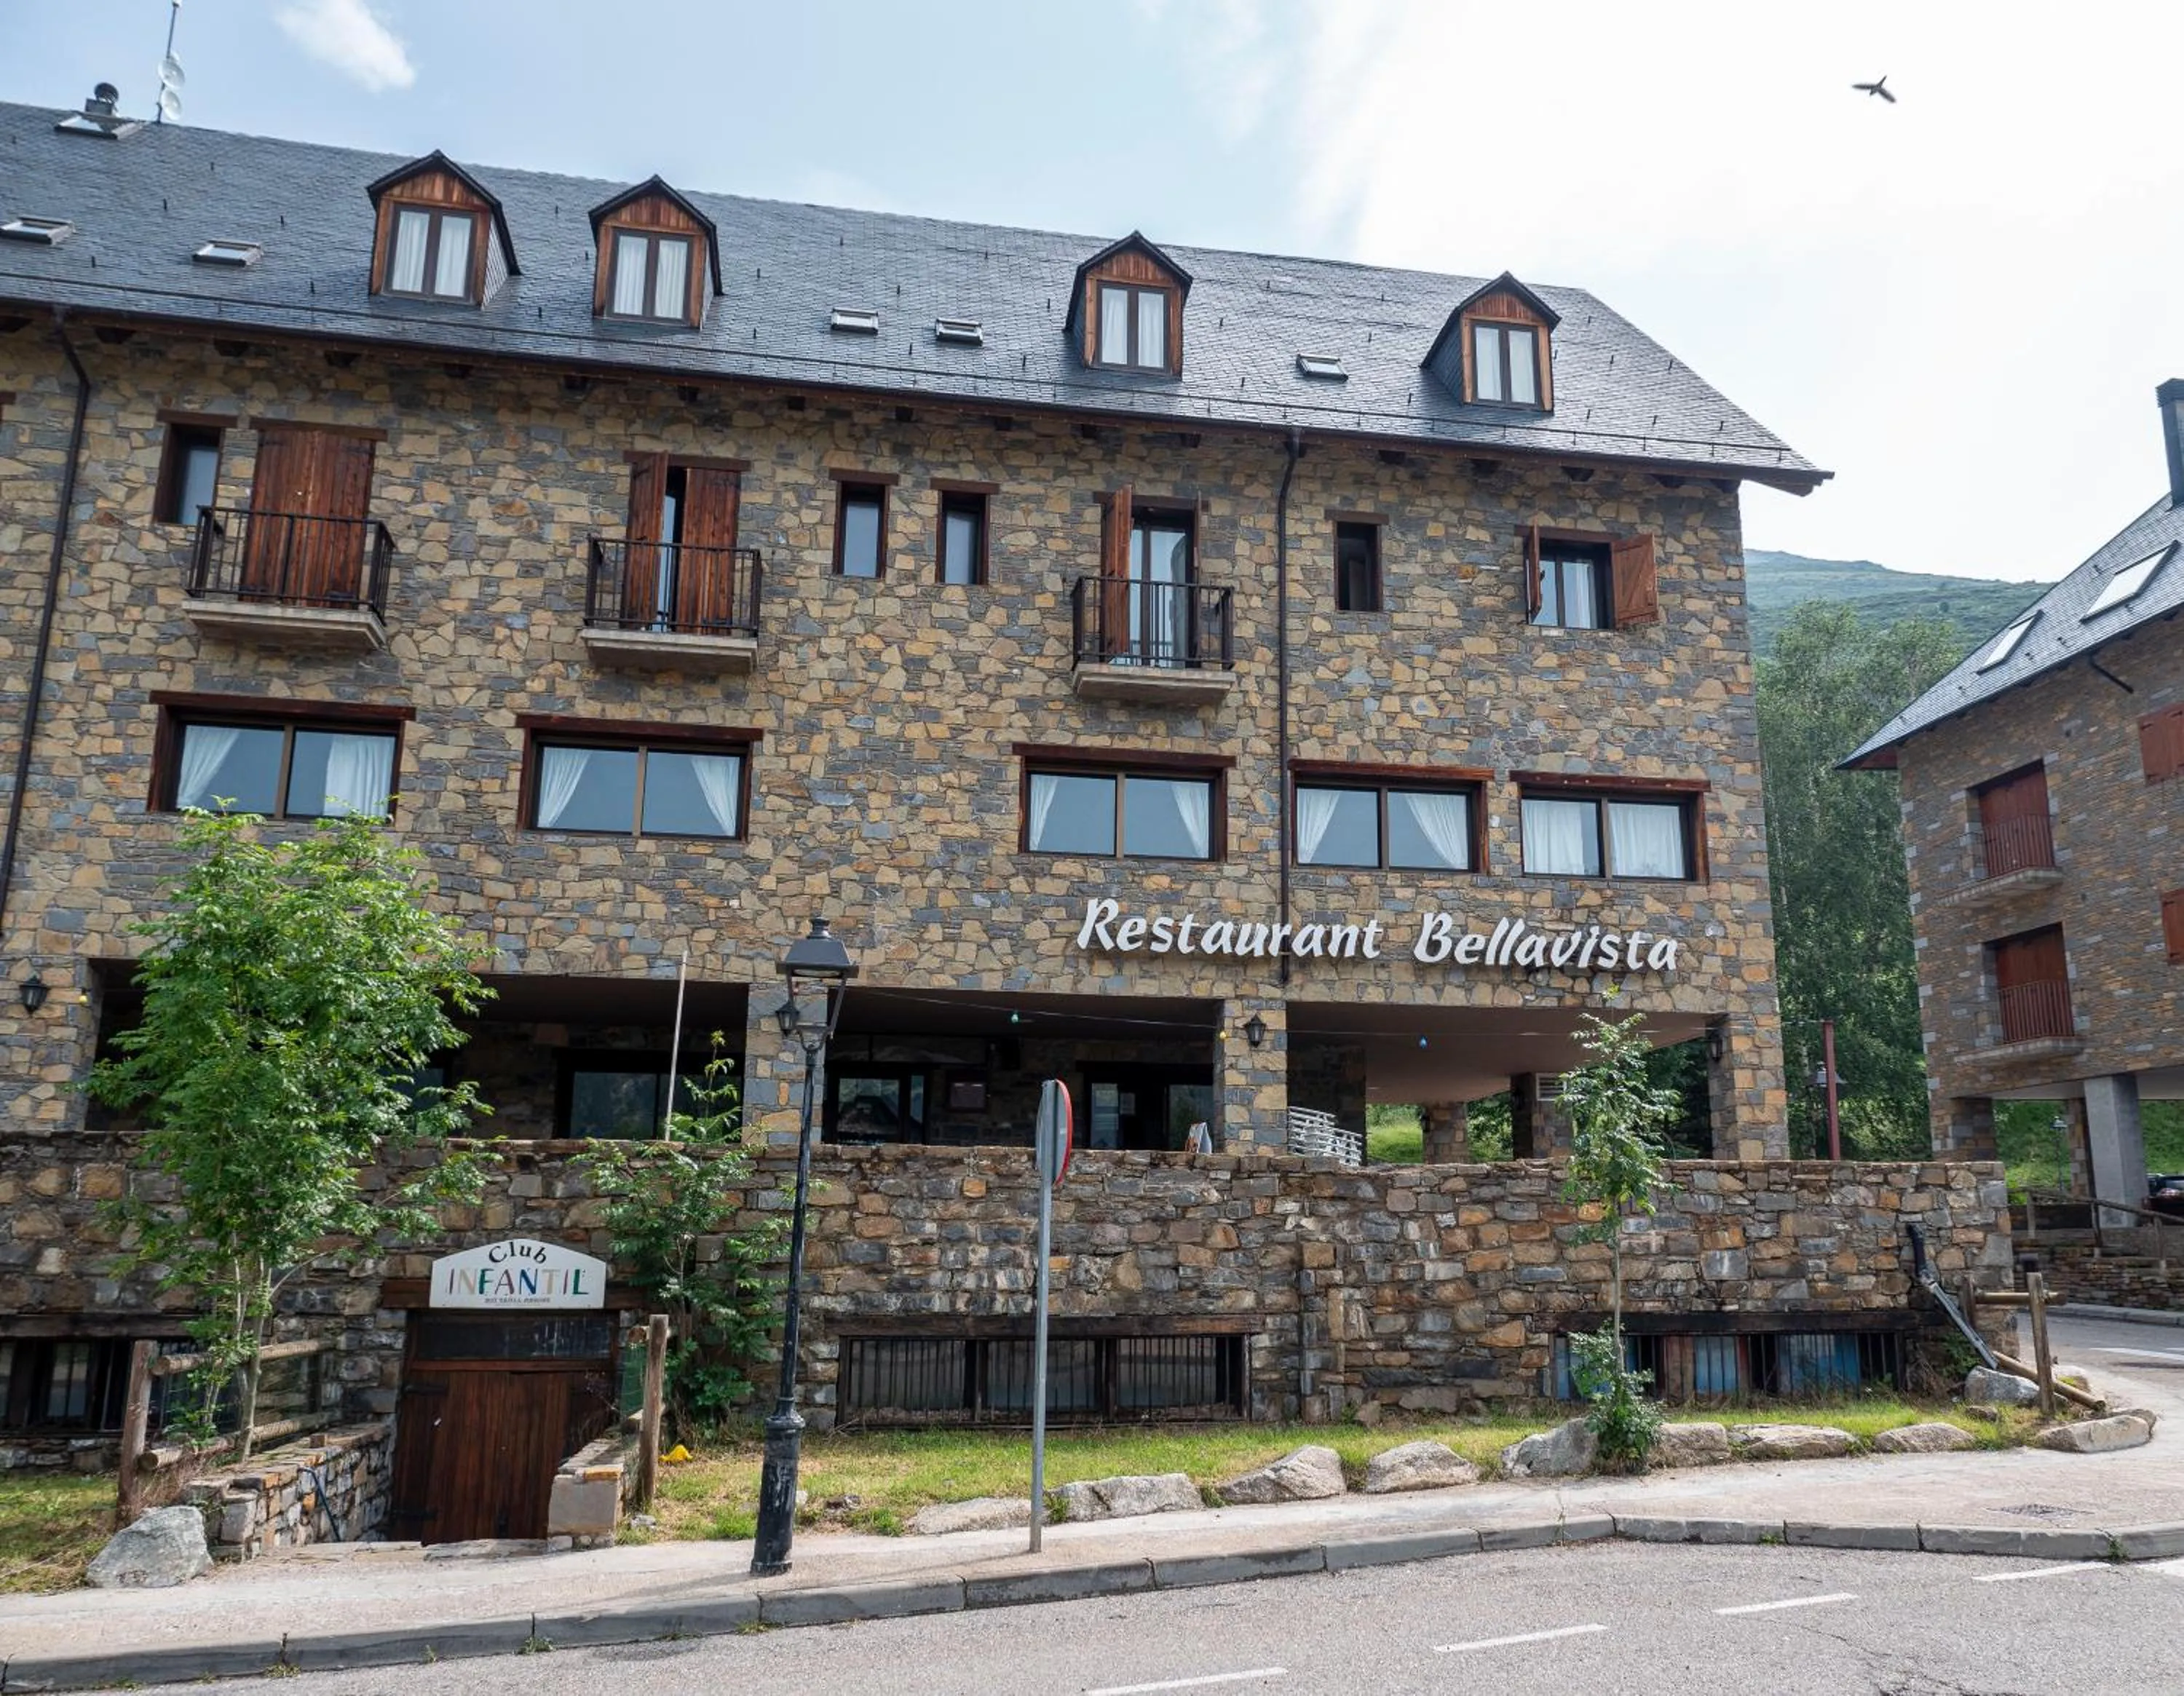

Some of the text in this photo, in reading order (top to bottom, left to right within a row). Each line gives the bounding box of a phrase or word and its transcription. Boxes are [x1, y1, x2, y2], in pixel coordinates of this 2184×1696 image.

[1077, 897, 1678, 970] Restaurant Bellavista
[488, 1242, 547, 1264] Club
[447, 1268, 589, 1296] INFANTIL
